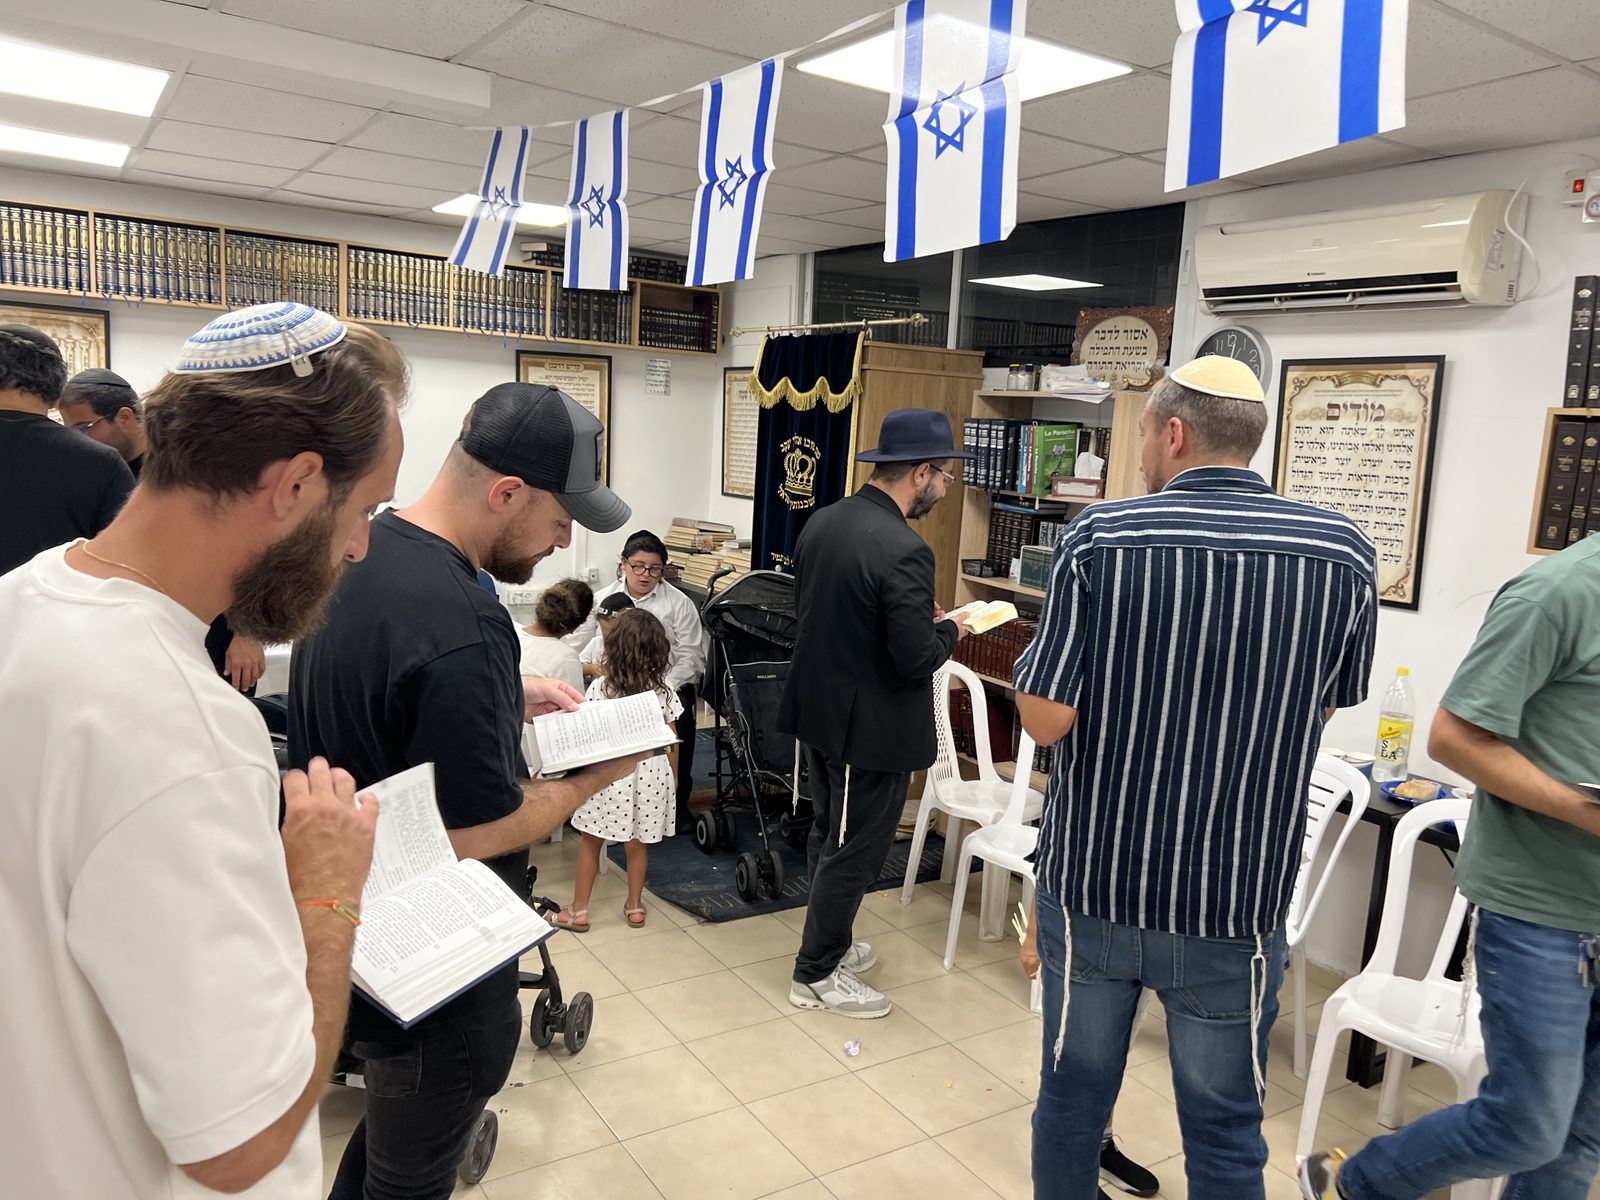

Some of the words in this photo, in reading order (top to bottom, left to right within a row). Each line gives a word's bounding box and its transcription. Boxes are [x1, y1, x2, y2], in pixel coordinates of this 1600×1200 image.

[1094, 325, 1120, 340] לדבר
[1123, 328, 1149, 340] אסור
[1089, 343, 1120, 356] התפילה
[1122, 346, 1147, 356] בשעת
[1216, 340, 1224, 352] 11
[1249, 349, 1258, 362] 2
[1088, 361, 1113, 371] התורה
[1115, 361, 1146, 373] וקריאת
[1326, 402, 1386, 422] מודים
